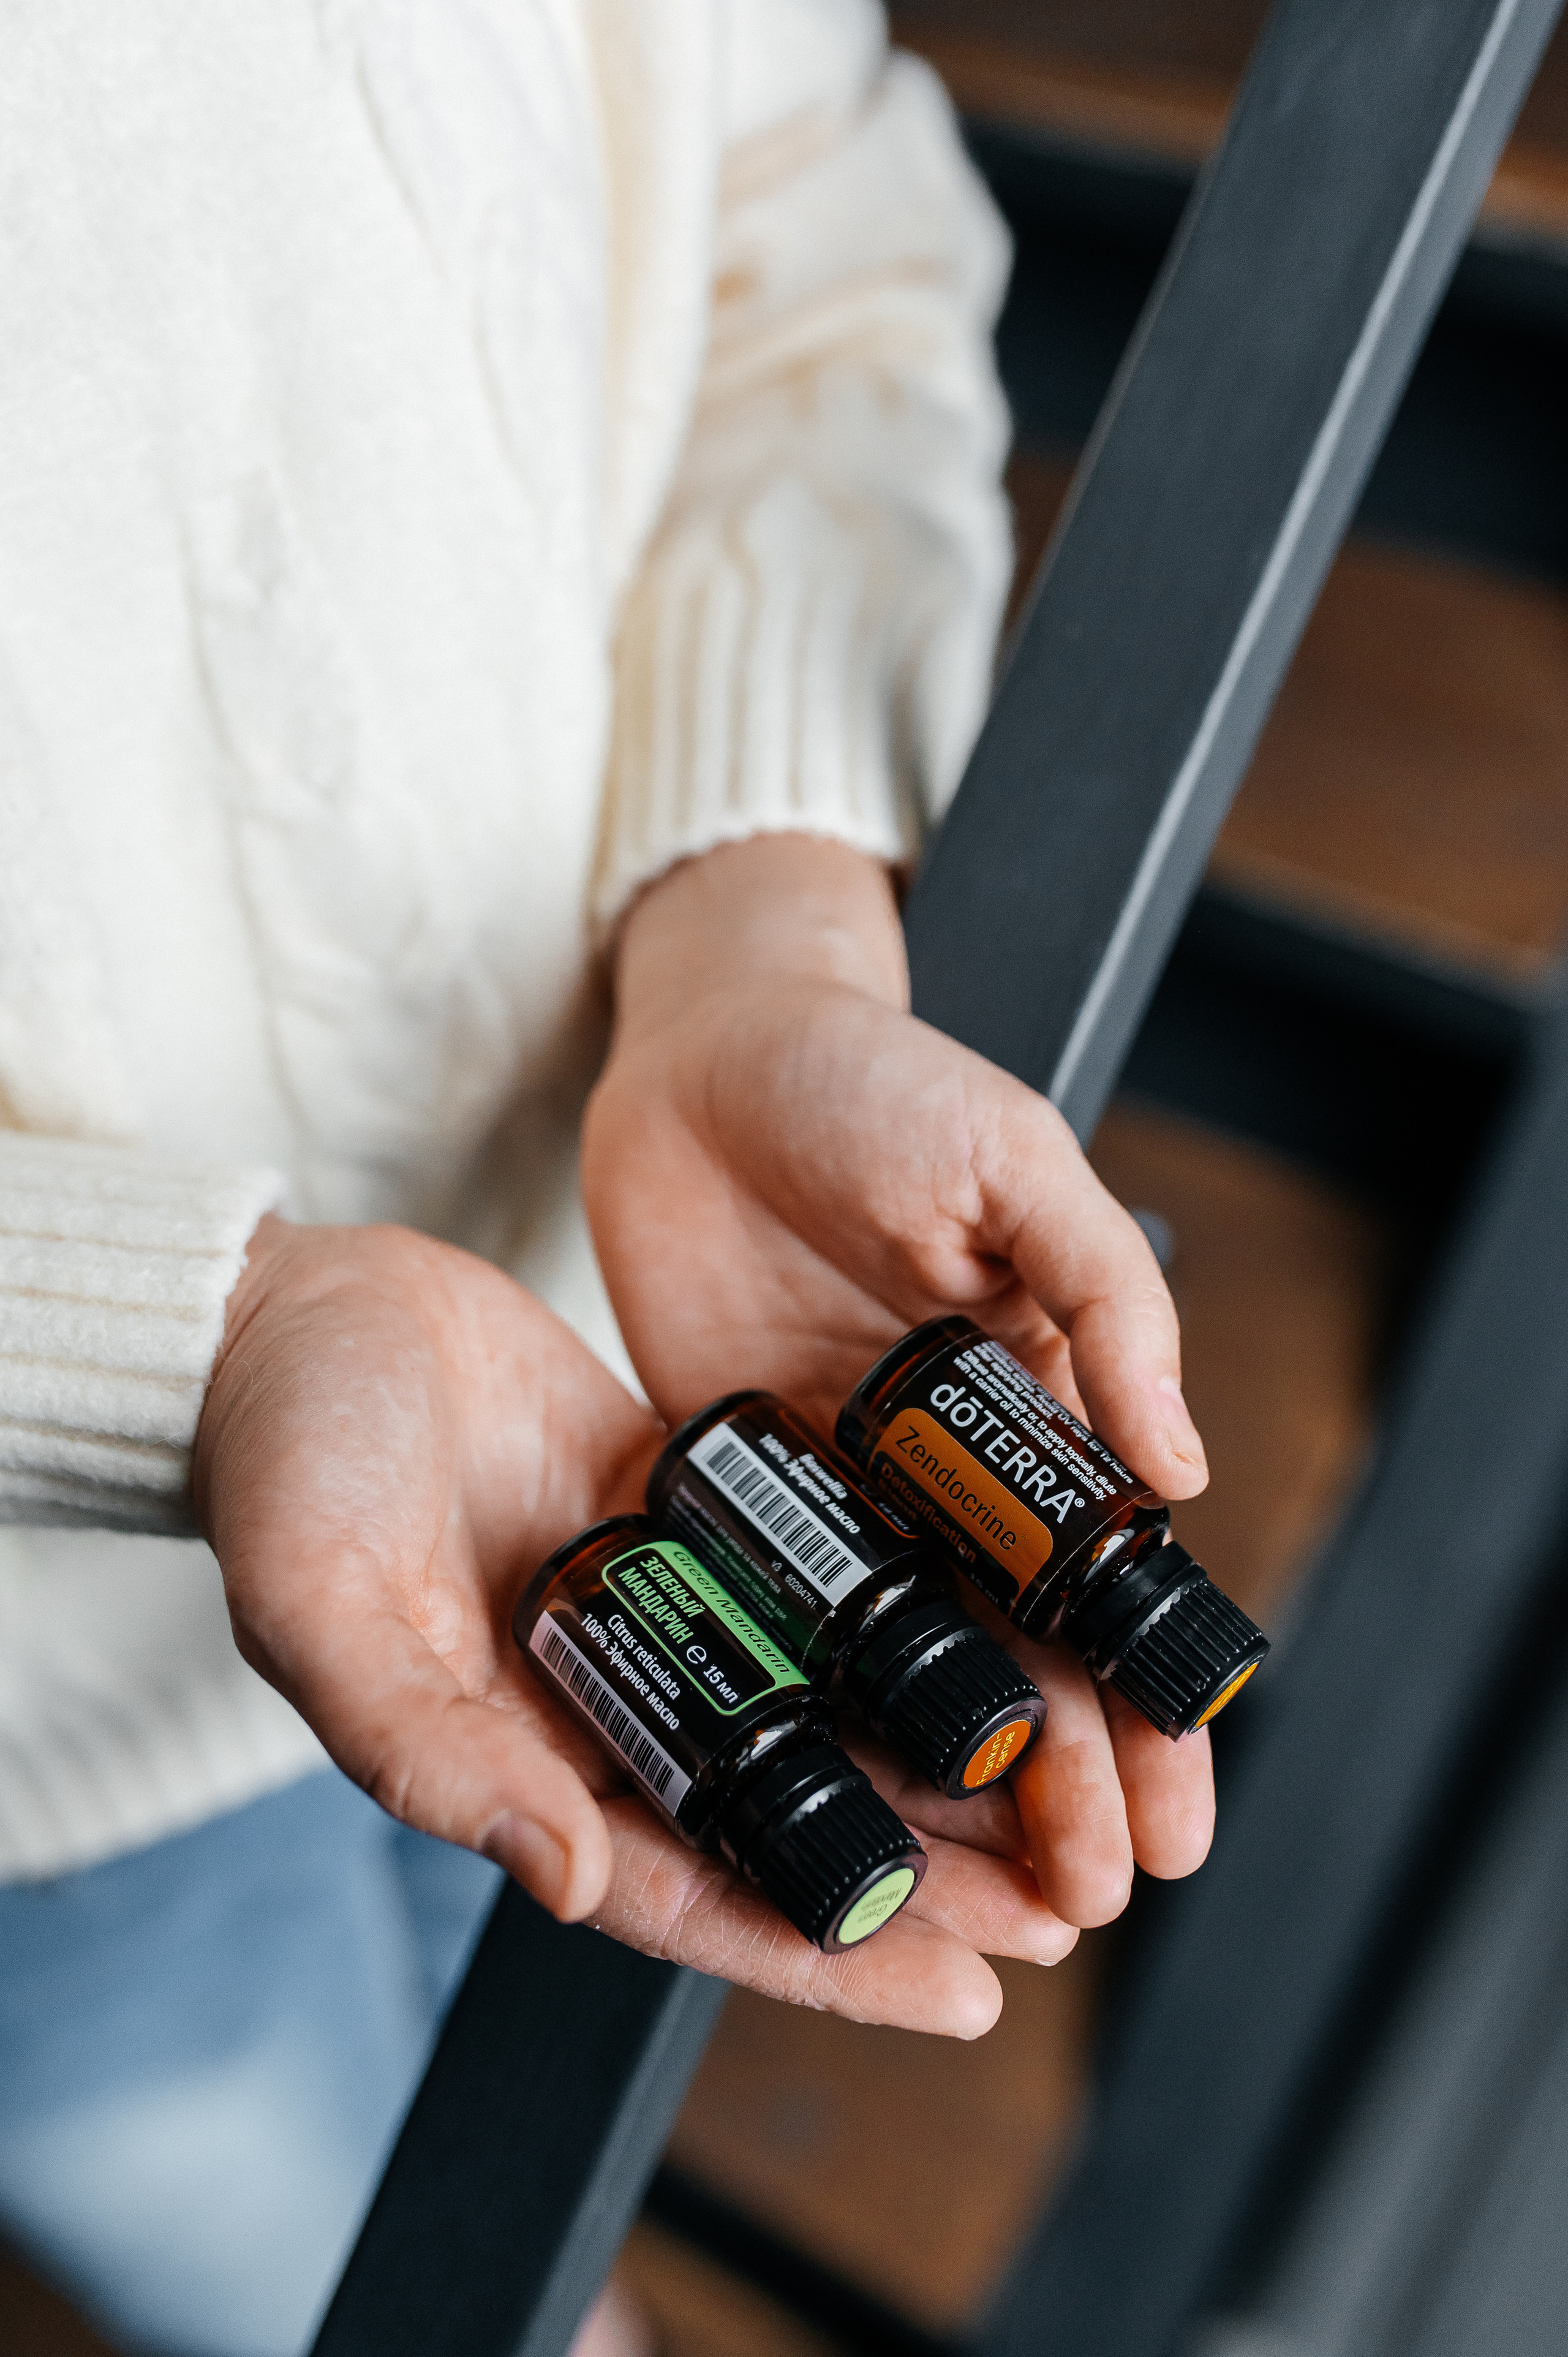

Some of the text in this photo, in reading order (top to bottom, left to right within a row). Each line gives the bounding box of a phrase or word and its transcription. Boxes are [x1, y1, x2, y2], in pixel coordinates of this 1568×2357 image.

[954, 1357, 971, 1373] with
[976, 1378, 1003, 1401] carrier
[1000, 1401, 1013, 1410] oil
[1009, 1409, 1020, 1418] to
[1017, 1418, 1053, 1449] minimize
[1051, 1449, 1069, 1465] skin
[1068, 1464, 1107, 1500] sensitivity.
[962, 1350, 989, 1375] Diffuse
[986, 1374, 1030, 1413] aromatically
[1028, 1412, 1039, 1423] or,
[1038, 1421, 1047, 1429] to
[1046, 1429, 1068, 1448] apply
[1065, 1447, 1096, 1477] topically,
[1096, 1475, 1117, 1494] dilute
[991, 1362, 1023, 1391] applying
[1020, 1391, 1053, 1420] product.
[799, 1454, 847, 1499] Boswellia
[1036, 1394, 1059, 1413] Avoid
[1058, 1412, 1074, 1424] UV
[1070, 1426, 1088, 1441] rays
[1088, 1442, 1099, 1451] for
[1100, 1453, 1111, 1462] 12
[1110, 1462, 1133, 1483] hours
[784, 1459, 830, 1504] Эфирное
[826, 1503, 860, 1534] масло
[880, 1461, 979, 1564] Detoxification
[618, 1567, 693, 1644] МАНДАРИН
[640, 1557, 705, 1617] ЗЕЛЕНЫЙ
[674, 1551, 718, 1594] Green
[716, 1600, 790, 1672] Mandarin
[581, 1614, 679, 1730] 100% Эфирное масло
[608, 1614, 680, 1700] Citrus reticulata
[704, 1666, 724, 1684] 15
[717, 1682, 738, 1703] мл
[995, 1731, 1016, 1769] cense
